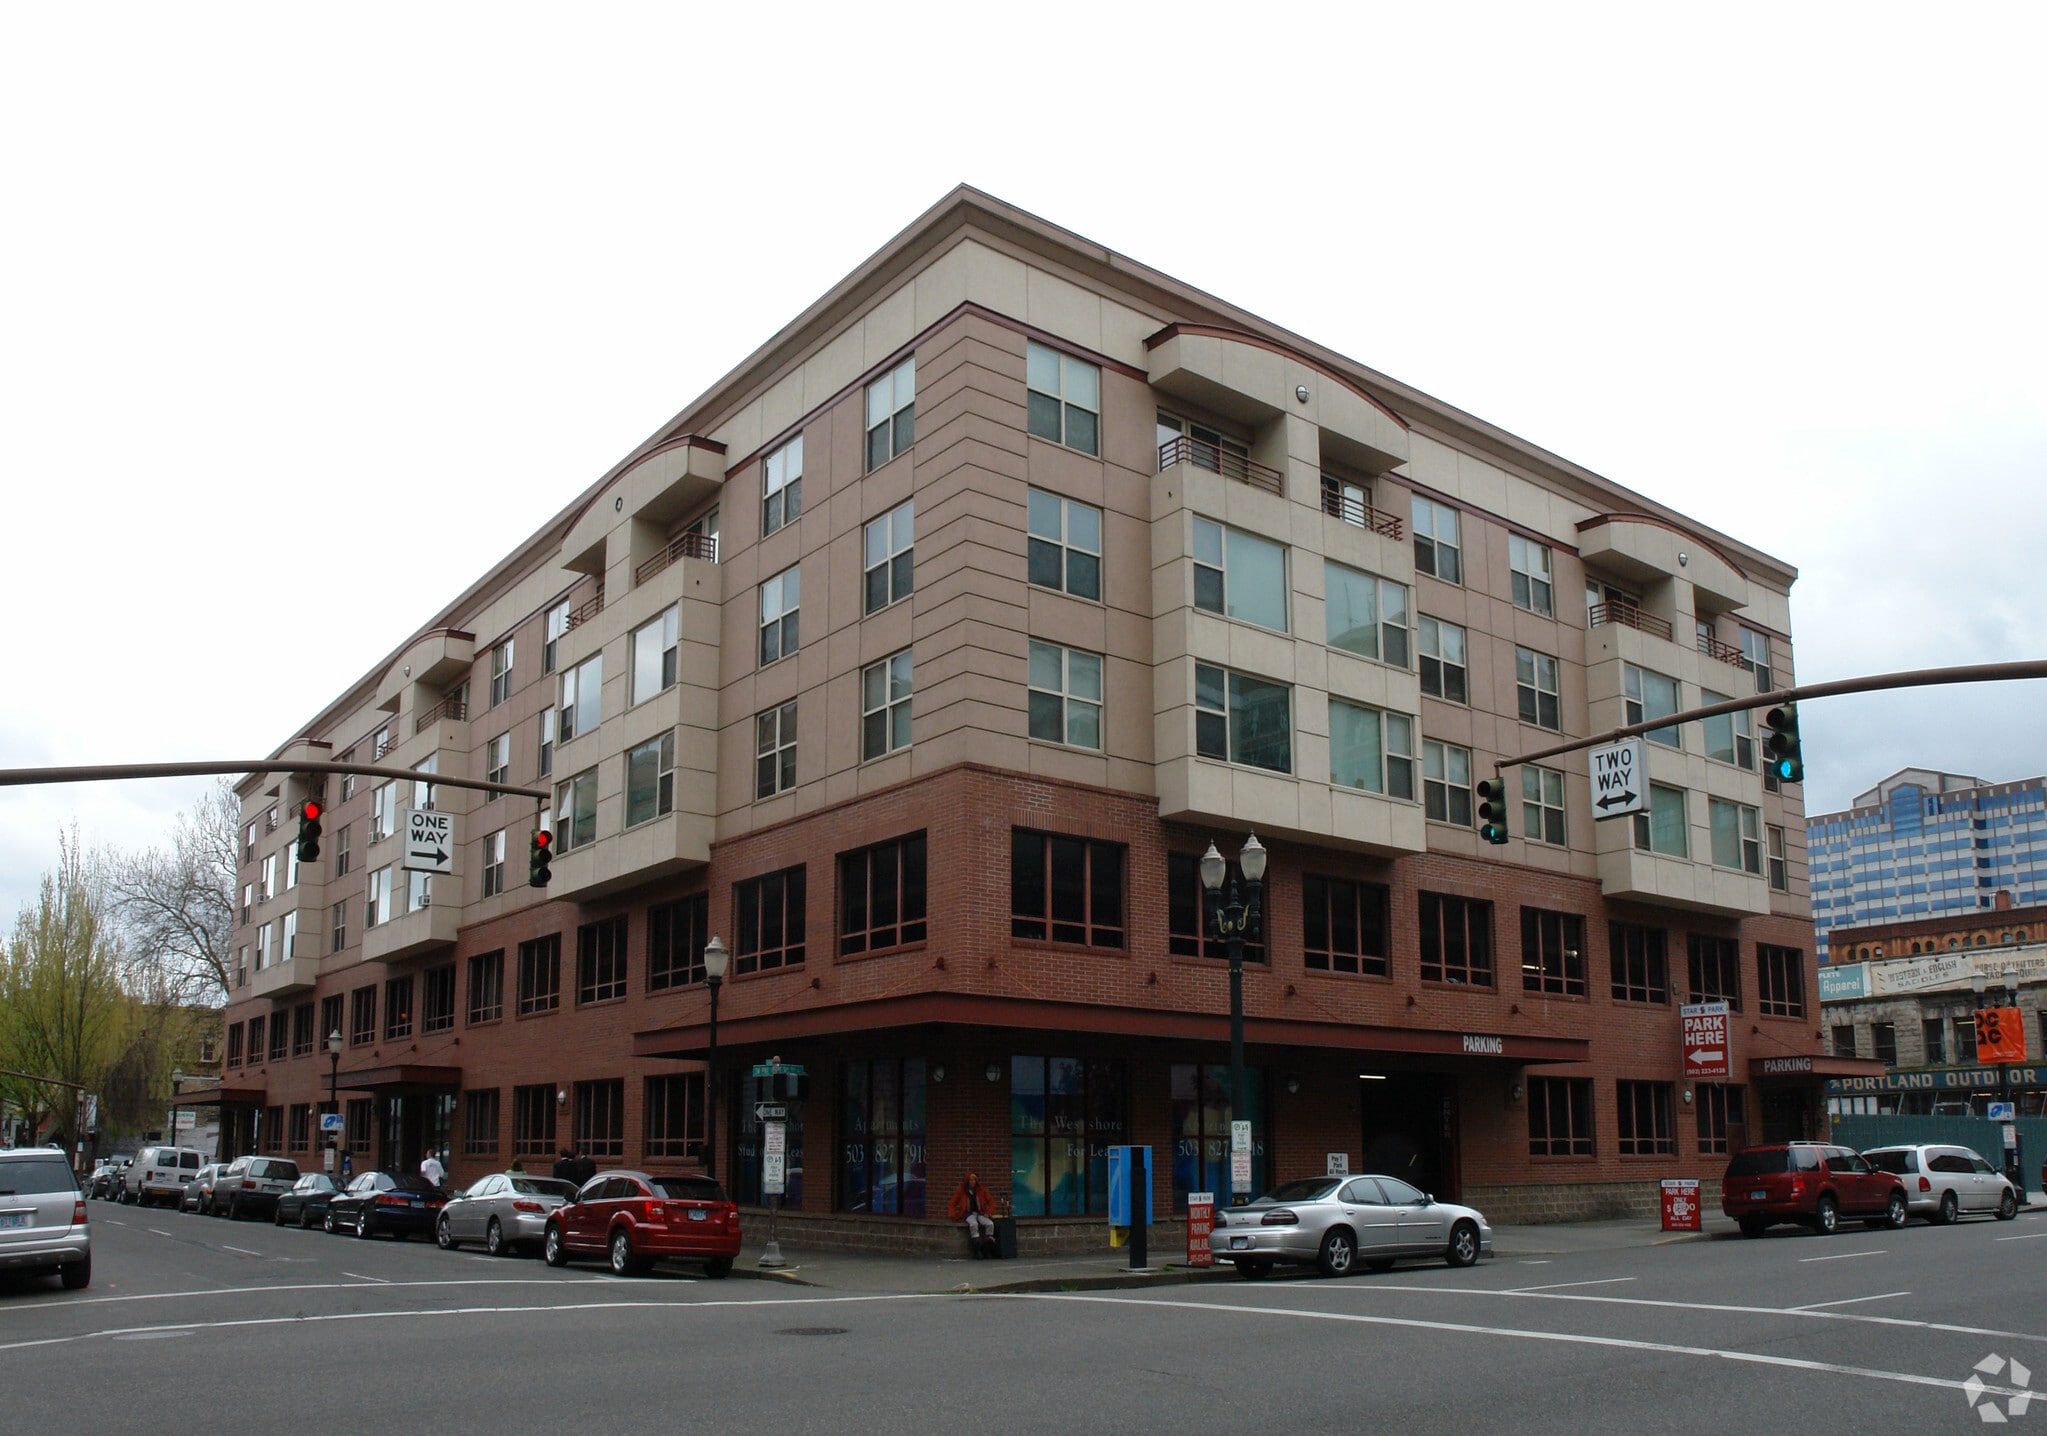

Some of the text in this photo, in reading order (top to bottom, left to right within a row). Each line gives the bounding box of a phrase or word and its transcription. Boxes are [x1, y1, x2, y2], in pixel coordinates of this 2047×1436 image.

[1595, 749, 1632, 771] TWO
[1598, 768, 1632, 791] WAY
[412, 814, 448, 829] ONE
[411, 829, 448, 844] WAY
[1888, 968, 1920, 982] WESTERN
[1928, 960, 1957, 974] ENGLISH
[1823, 978, 1860, 993] Apparel
[1897, 972, 1949, 988] SADDLES
[1683, 1007, 1697, 1015] STAR
[1708, 1005, 1724, 1013] PARK
[1684, 1016, 1724, 1032] PARK
[1463, 1035, 1502, 1053] PARKING
[1685, 1030, 1725, 1046] HERE
[1764, 1058, 1811, 1072] PARKING
[1842, 1073, 1934, 1091] PORTLAND
[1945, 1068, 2037, 1087] OUTDOR
[774, 1107, 785, 1116] WAY
[1054, 1115, 1123, 1131] Wesshore
[846, 1144, 865, 1164] 503
[874, 1144, 895, 1165] 827
[1090, 1143, 1109, 1157] Lea
[1178, 1140, 1199, 1157] 503
[1208, 1140, 1230, 1158] 827
[1190, 1206, 1211, 1219] MONTHLY
[1191, 1222, 1210, 1235] PARKING
